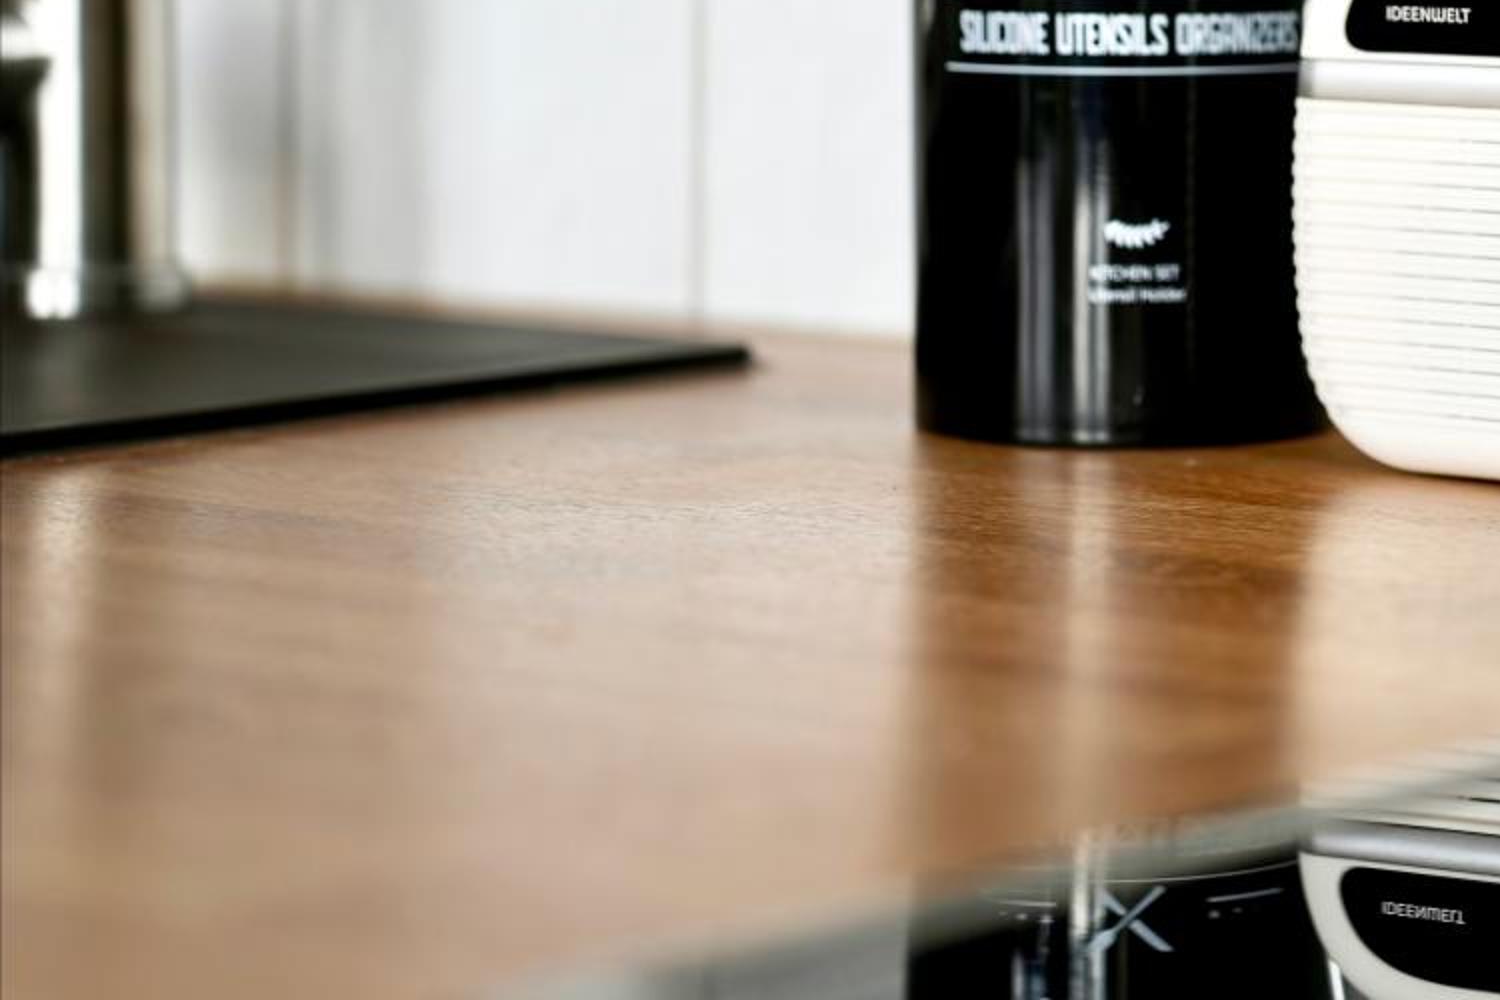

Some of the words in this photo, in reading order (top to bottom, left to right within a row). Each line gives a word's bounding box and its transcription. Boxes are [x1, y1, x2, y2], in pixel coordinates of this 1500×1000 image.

[1385, 4, 1472, 24] IDEENWELT
[959, 9, 1050, 54] SILICONE
[1055, 12, 1169, 56] UTENSILS
